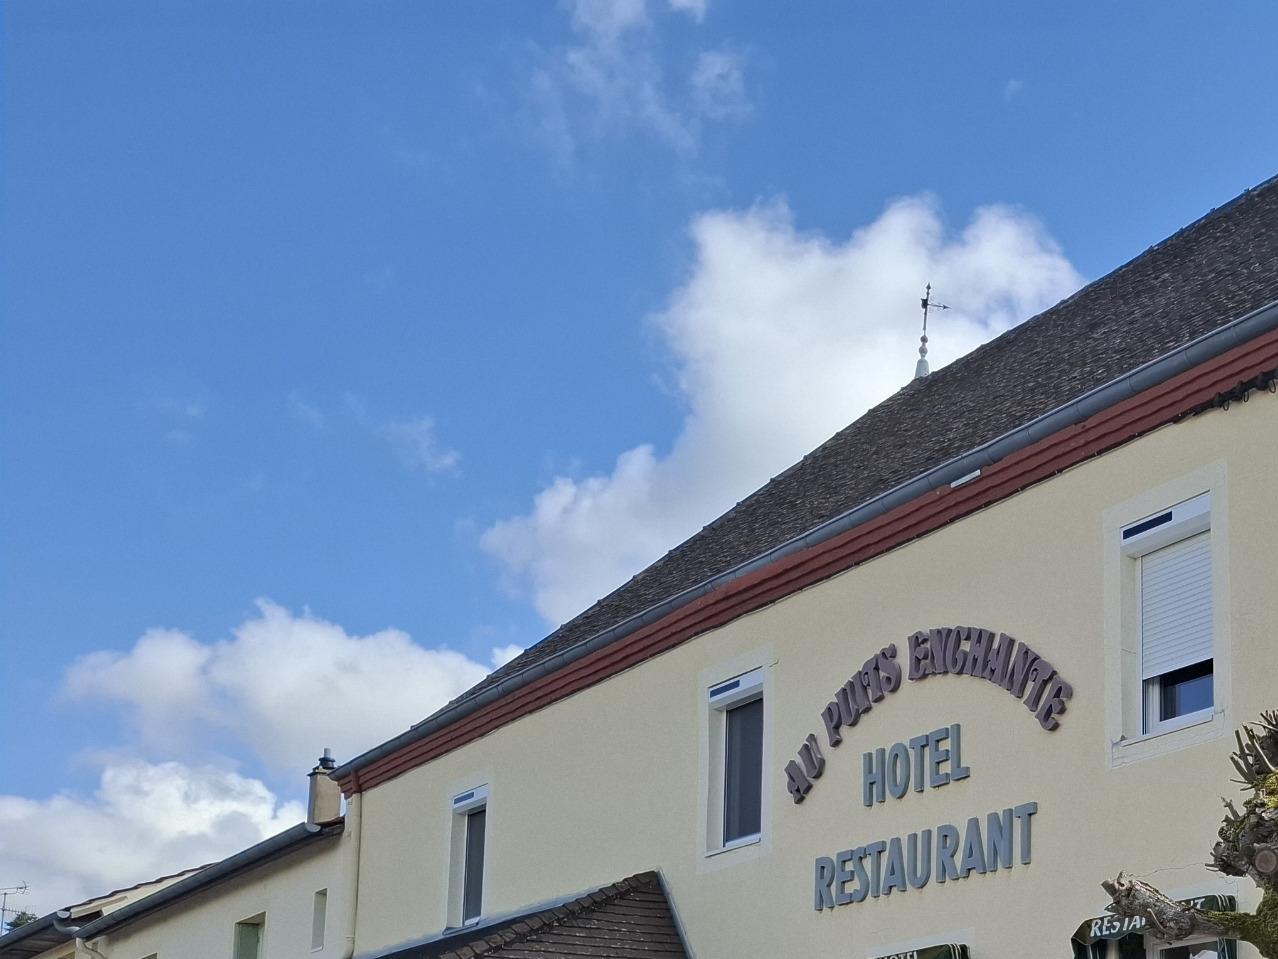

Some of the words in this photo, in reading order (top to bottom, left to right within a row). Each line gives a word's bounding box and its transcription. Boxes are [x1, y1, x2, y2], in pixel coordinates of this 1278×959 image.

[784, 733, 826, 805] AU
[820, 643, 902, 747] PUITS
[862, 723, 970, 807] HOTEL
[814, 802, 1038, 911] RESTAURANT
